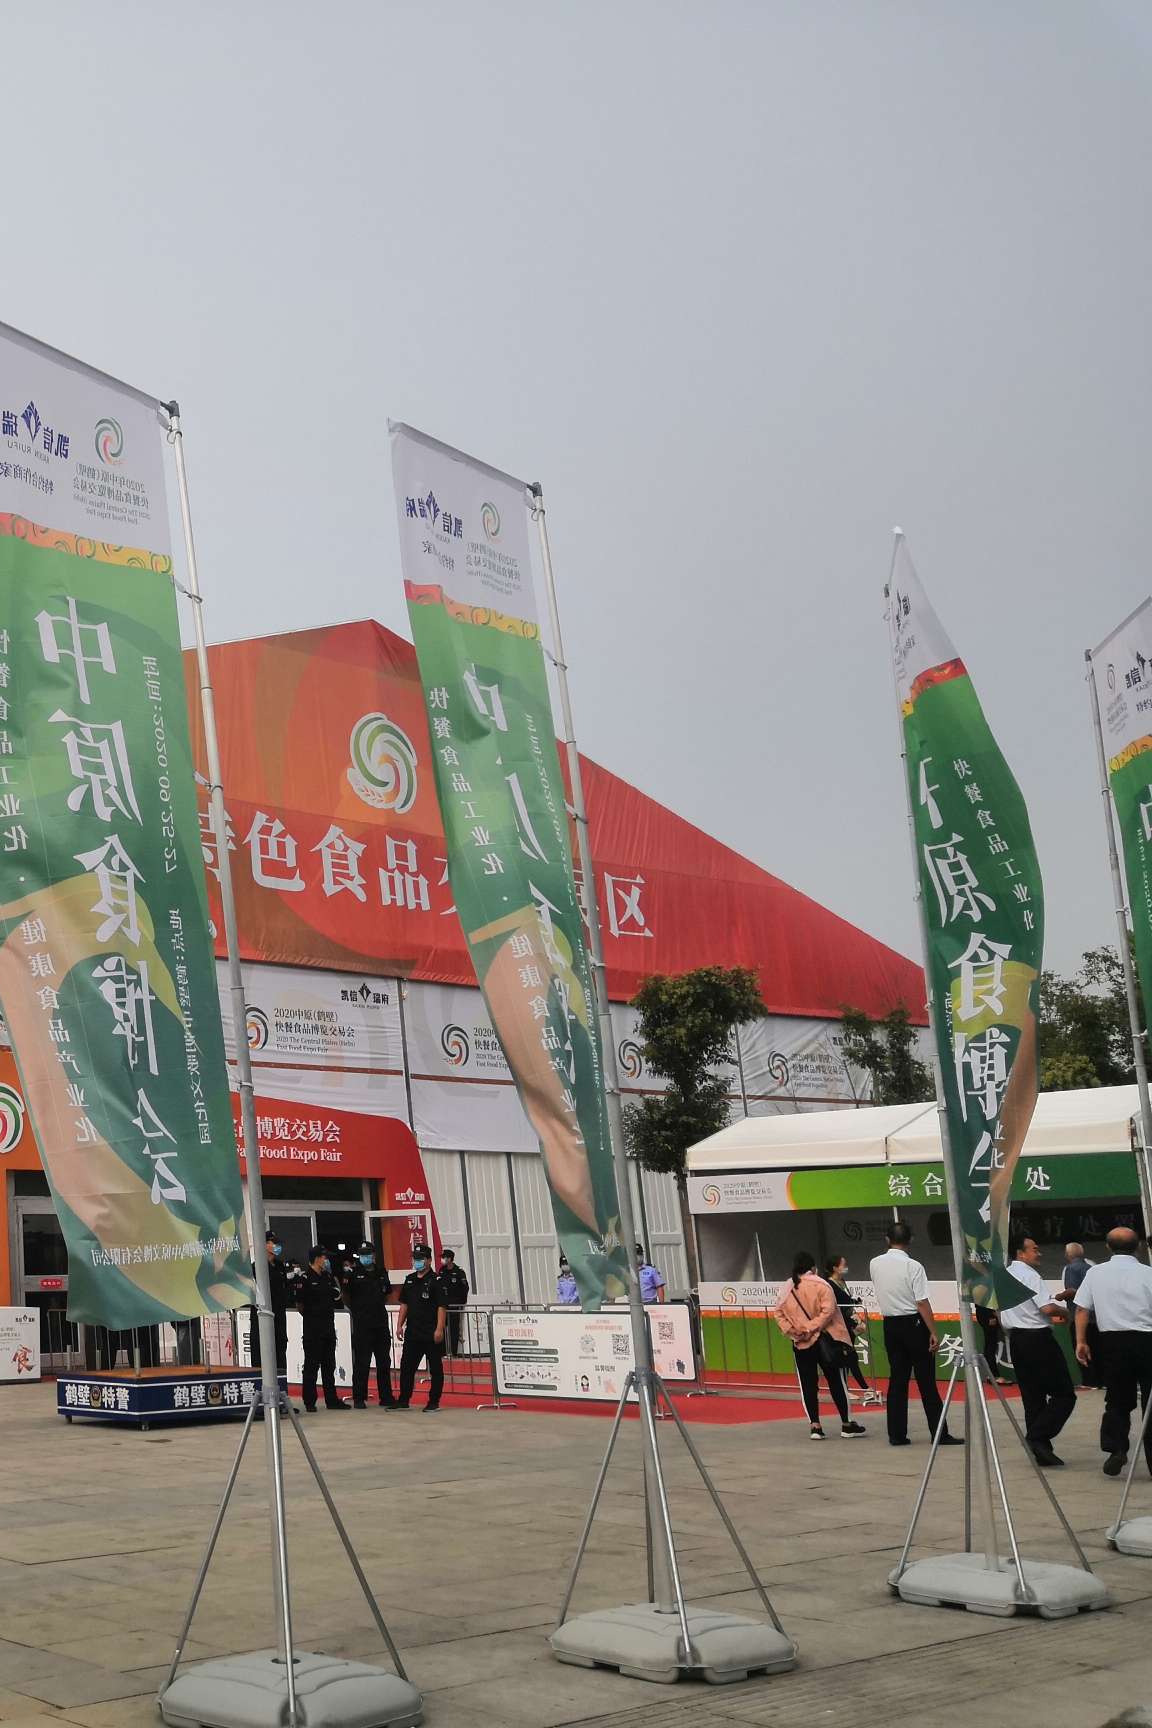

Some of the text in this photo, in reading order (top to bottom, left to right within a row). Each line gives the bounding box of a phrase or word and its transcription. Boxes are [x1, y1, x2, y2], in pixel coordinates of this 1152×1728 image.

[952, 758, 1035, 931] 快餐食品工业化
[341, 989, 389, 1005] 凯信 瑞府
[275, 1022, 355, 1038] 快餐食品博览交易会
[300, 1037, 321, 1045] Central
[233, 1115, 341, 1143] 博览交易会
[259, 1145, 288, 1159] Food
[290, 1147, 318, 1164] Expo
[319, 1148, 343, 1162] Fair
[65, 1383, 130, 1411] 鹤壁 特警
[173, 1381, 256, 1409] 鹤壁 特警
